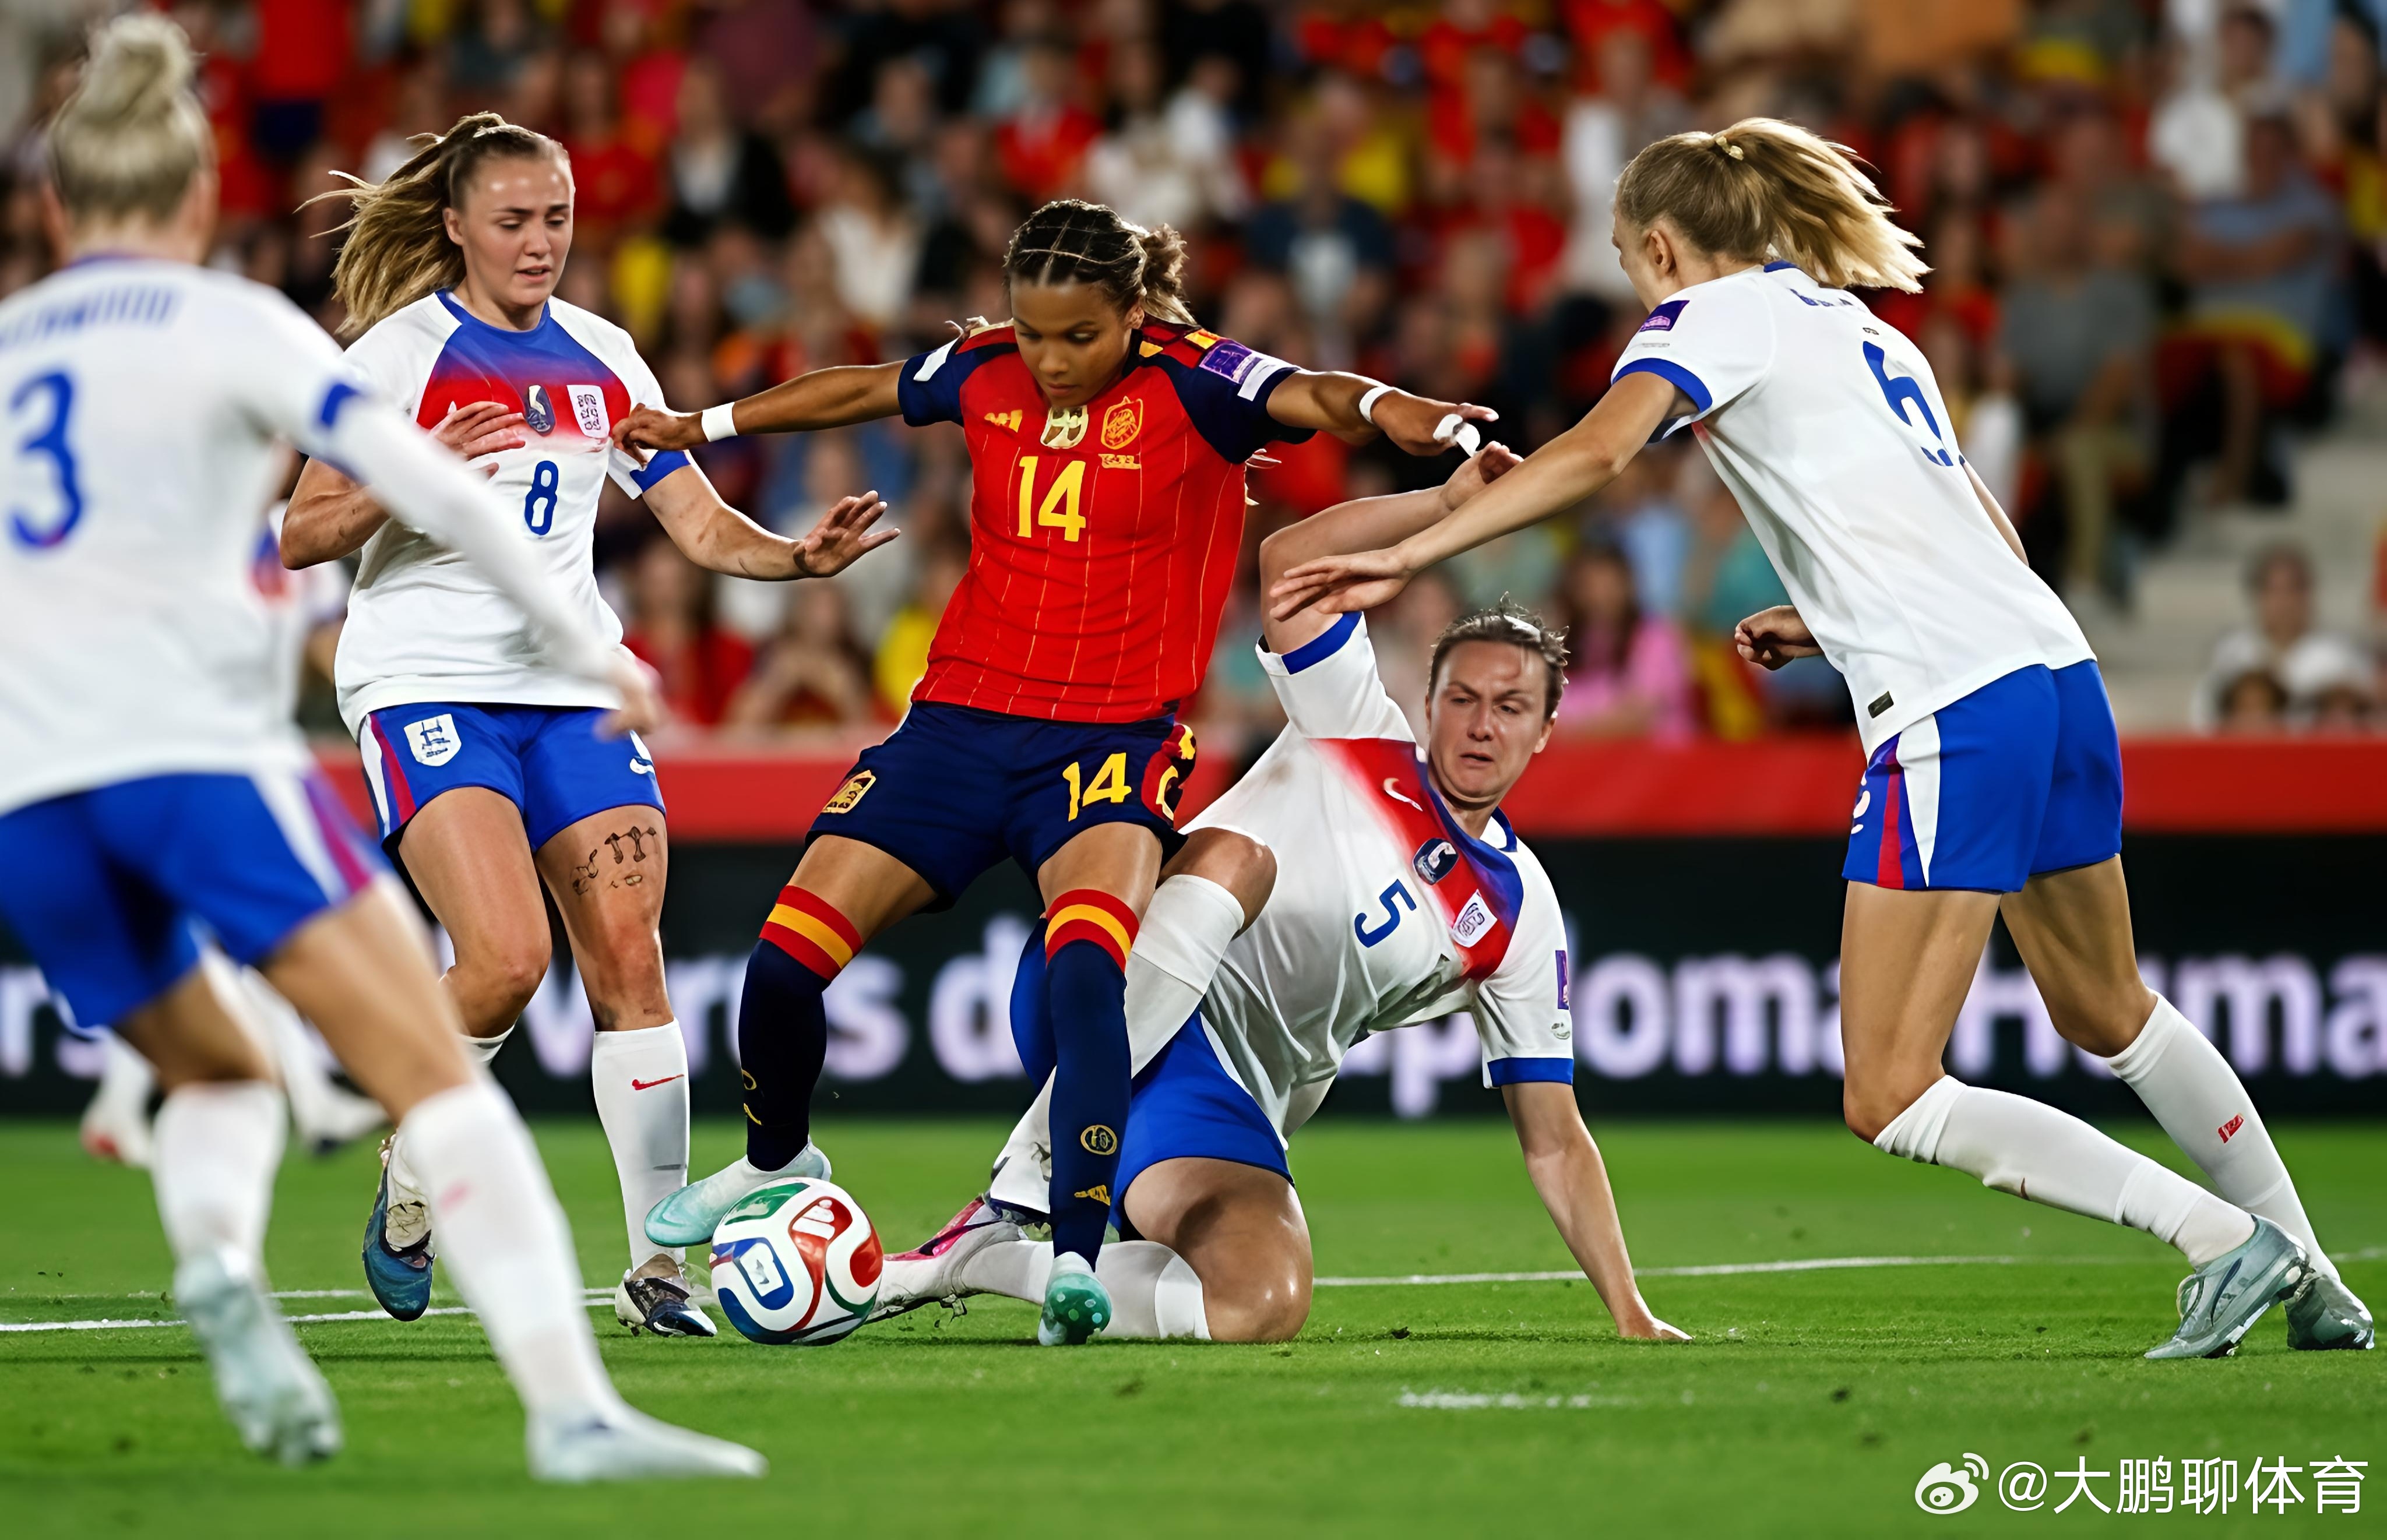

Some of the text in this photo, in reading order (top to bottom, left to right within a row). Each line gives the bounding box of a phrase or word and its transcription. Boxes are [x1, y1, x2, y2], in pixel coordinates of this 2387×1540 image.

[9, 368, 83, 549] 3
[524, 460, 559, 536] 8
[1017, 456, 1086, 542] 14
[1062, 752, 1132, 822] 14
[1354, 879, 1417, 949] 5
